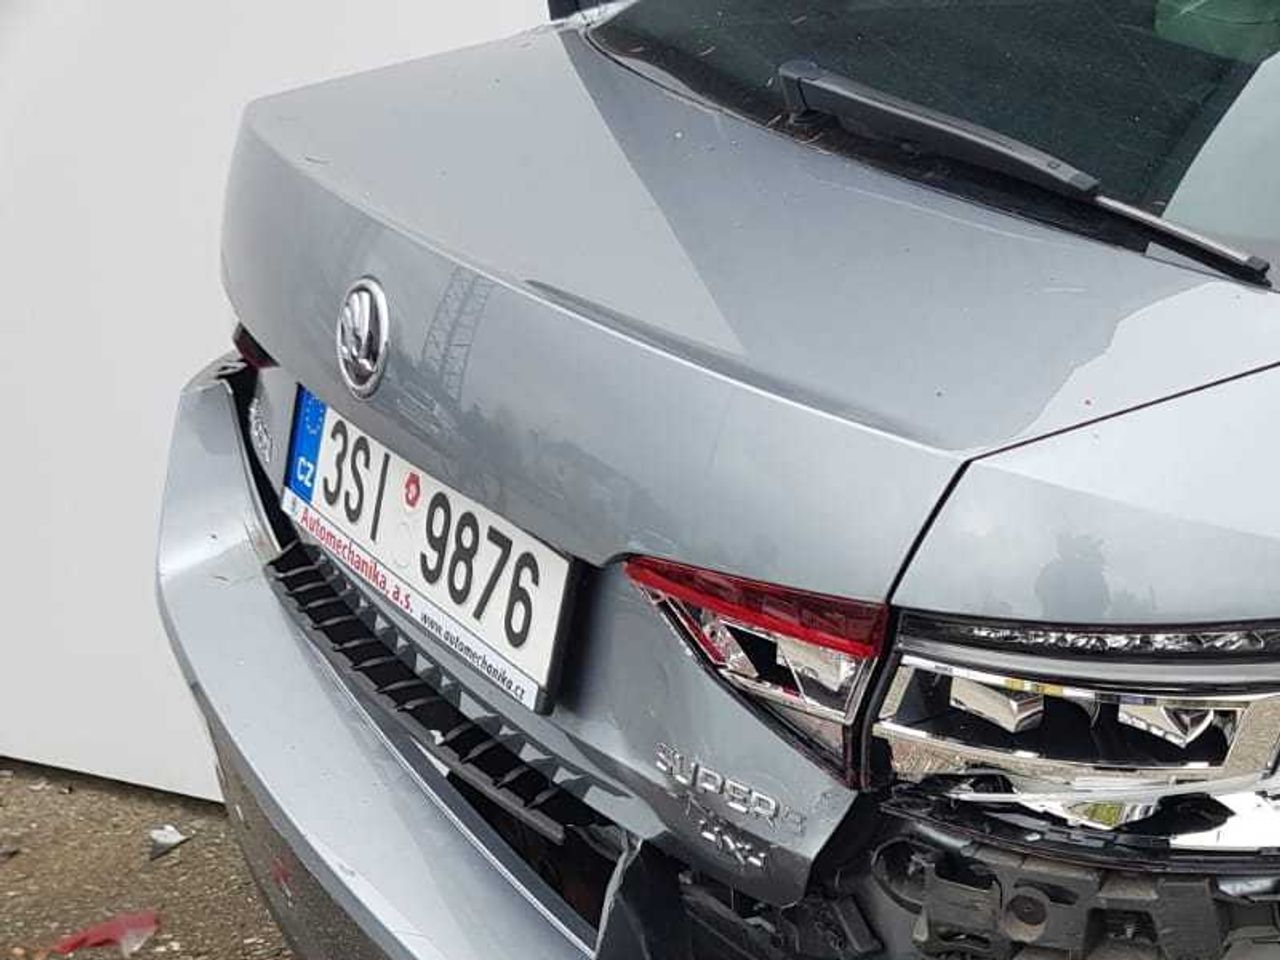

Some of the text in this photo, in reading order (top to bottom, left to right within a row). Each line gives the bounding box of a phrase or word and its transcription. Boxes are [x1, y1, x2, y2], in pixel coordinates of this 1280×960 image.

[297, 456, 314, 487] CZ
[301, 507, 413, 613] Automechanika, a.s.
[323, 420, 390, 541] 3SI
[420, 492, 540, 648] 9876
[421, 614, 525, 699] www.automechanika.cz
